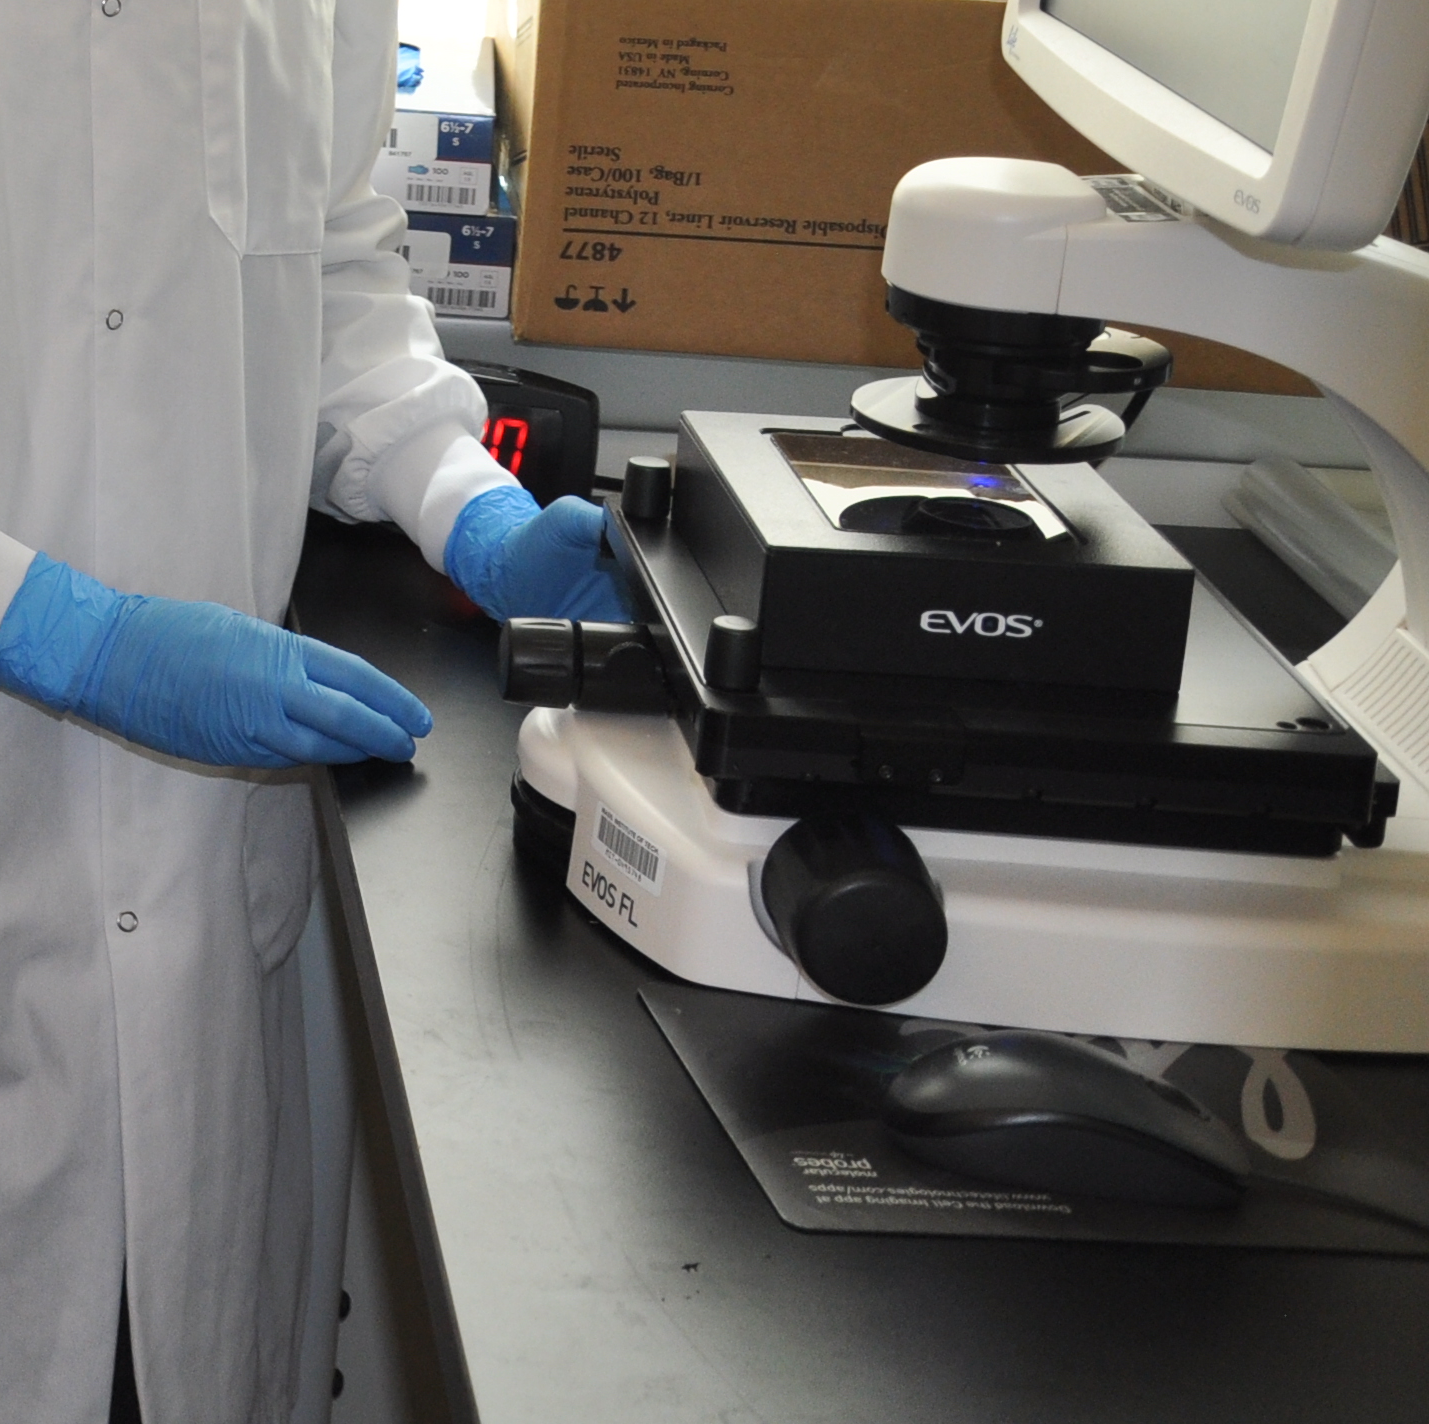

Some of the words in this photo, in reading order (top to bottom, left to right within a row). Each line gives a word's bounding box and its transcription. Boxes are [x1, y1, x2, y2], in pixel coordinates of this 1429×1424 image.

[619, 37, 659, 49] Mexico
[662, 38, 673, 49] in
[677, 37, 727, 52] Packaged
[618, 51, 643, 62] USA
[646, 52, 657, 63] in
[660, 53, 690, 65] Made
[618, 66, 650, 77] 14831
[659, 68, 676, 78] NY
[615, 79, 686, 93] Incorporated
[688, 81, 734, 95] Corning
[451, 137, 460, 146] S
[569, 145, 621, 161] Sterile
[432, 167, 449, 175] 100
[567, 166, 643, 183] 100/Case
[649, 165, 702, 186] 1/Bag,
[565, 185, 660, 205] Polystyrene
[564, 207, 633, 225] Channel
[639, 211, 658, 225] 12
[665, 210, 714, 229] Liner,
[718, 215, 797, 234] Reservoir
[473, 240, 481, 249] S
[559, 240, 623, 262] 4877
[581, 860, 617, 908] EVOS
[618, 892, 638, 928] FL
[793, 1157, 872, 1171] probes
[802, 1167, 878, 1178] molecular
[816, 1195, 831, 1204] at
[834, 1194, 862, 1204] app
[865, 1195, 929, 1207] Imaging
